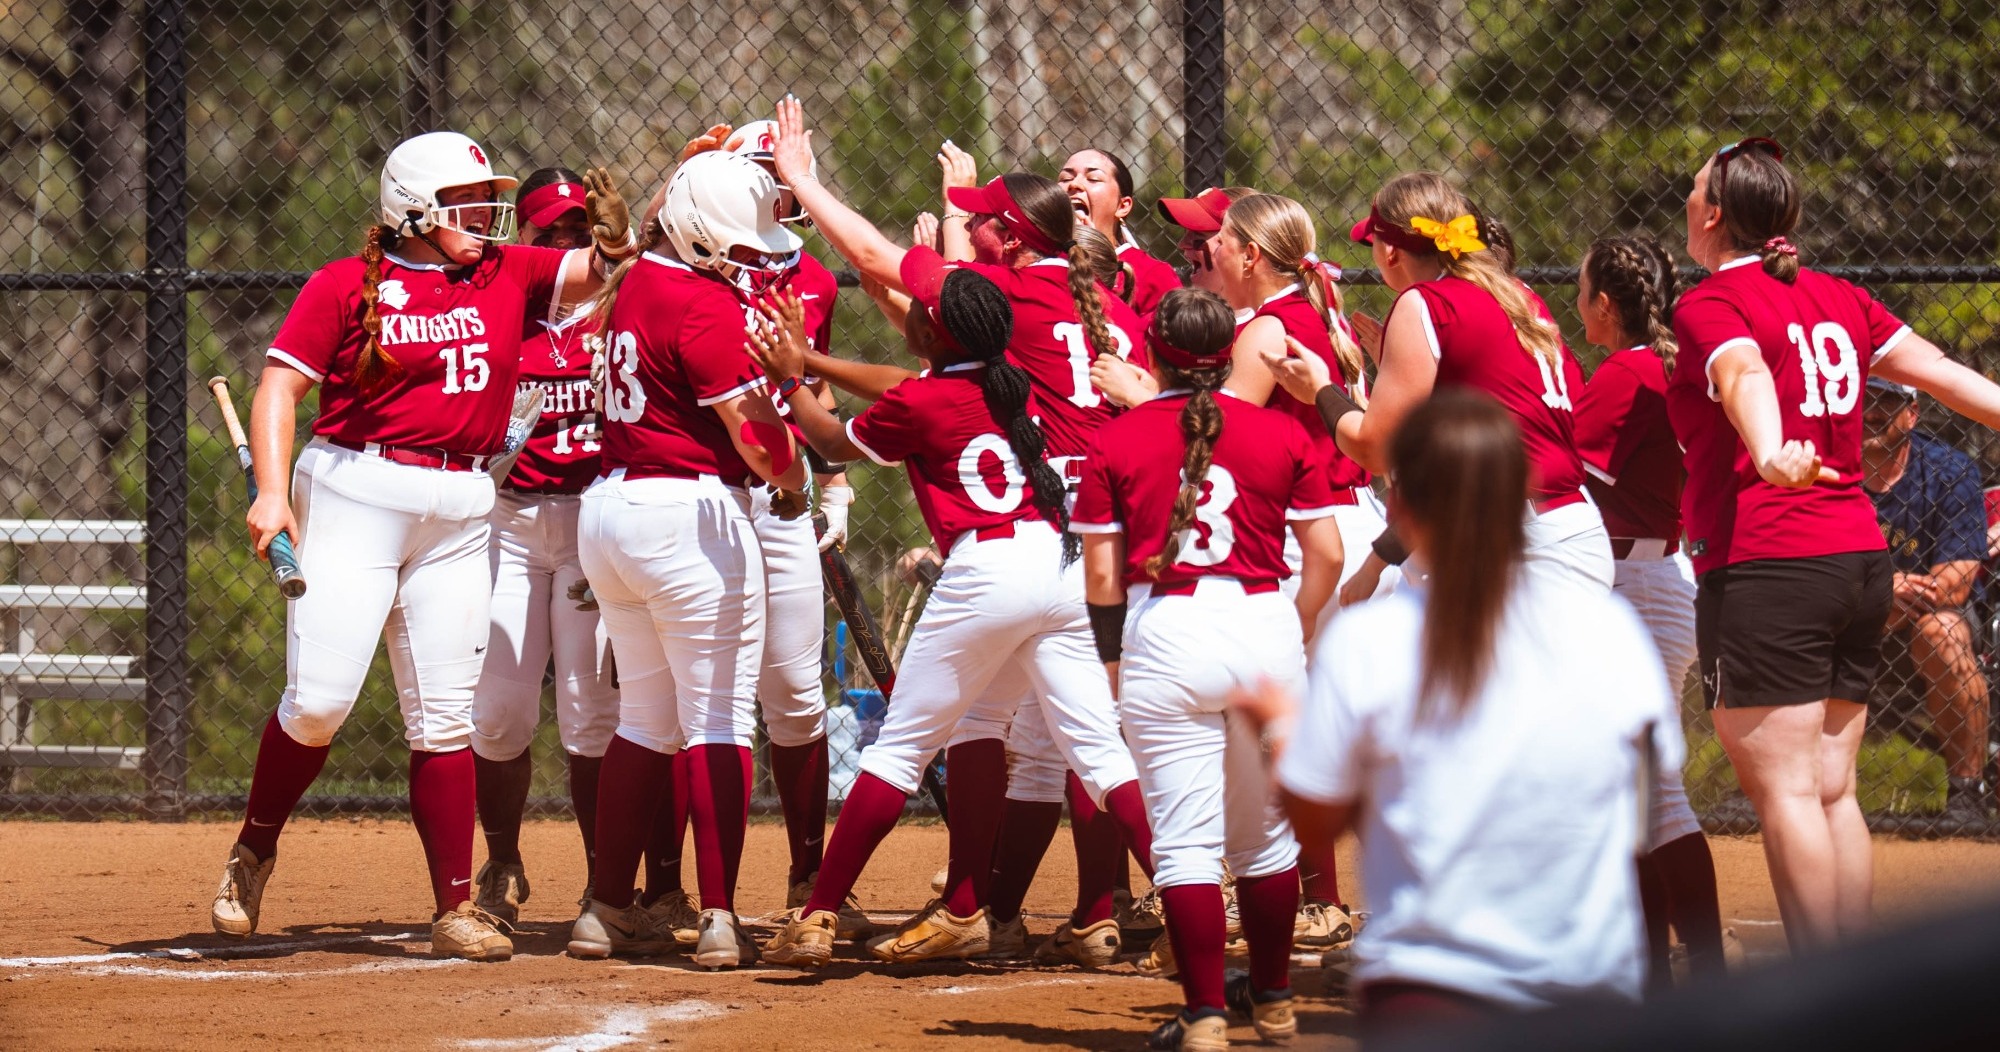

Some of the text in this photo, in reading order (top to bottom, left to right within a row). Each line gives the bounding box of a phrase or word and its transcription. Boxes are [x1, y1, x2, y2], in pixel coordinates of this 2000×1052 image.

[381, 306, 485, 346] KNIGHTS
[439, 342, 491, 395] 15
[604, 329, 647, 423] 13
[1787, 321, 1860, 417] 19
[552, 413, 601, 454] 14
[1174, 463, 1239, 567] 3
